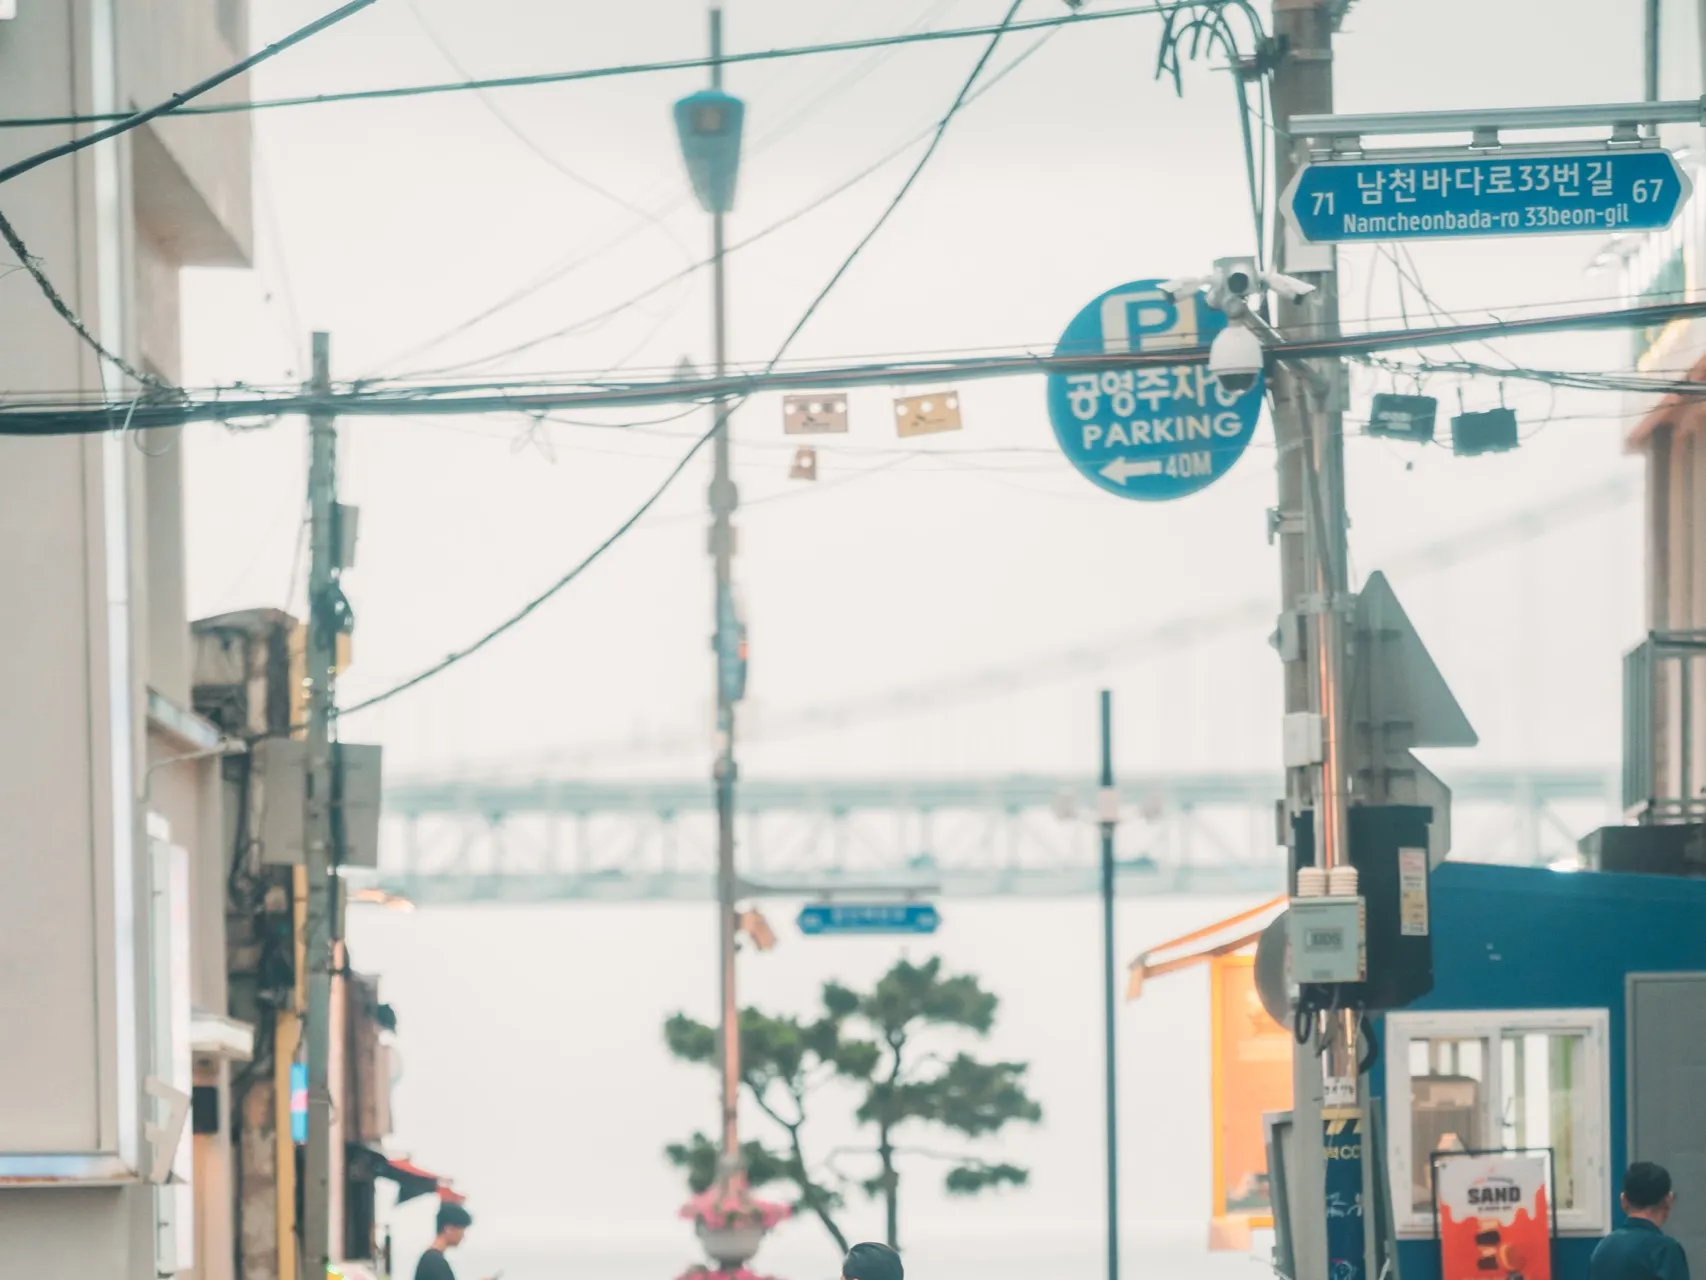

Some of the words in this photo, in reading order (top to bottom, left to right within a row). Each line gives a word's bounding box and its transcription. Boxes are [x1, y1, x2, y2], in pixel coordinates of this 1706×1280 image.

[1357, 161, 1614, 206] 남천바다로33번길
[1632, 178, 1664, 204] 67
[1310, 191, 1335, 216] 71
[1343, 208, 1521, 234] Namcheonbada-ro
[1524, 203, 1630, 229] 33beon-gil
[1082, 411, 1243, 450] PARKING
[1165, 452, 1213, 478] 40M
[1467, 1186, 1521, 1205] SAND
